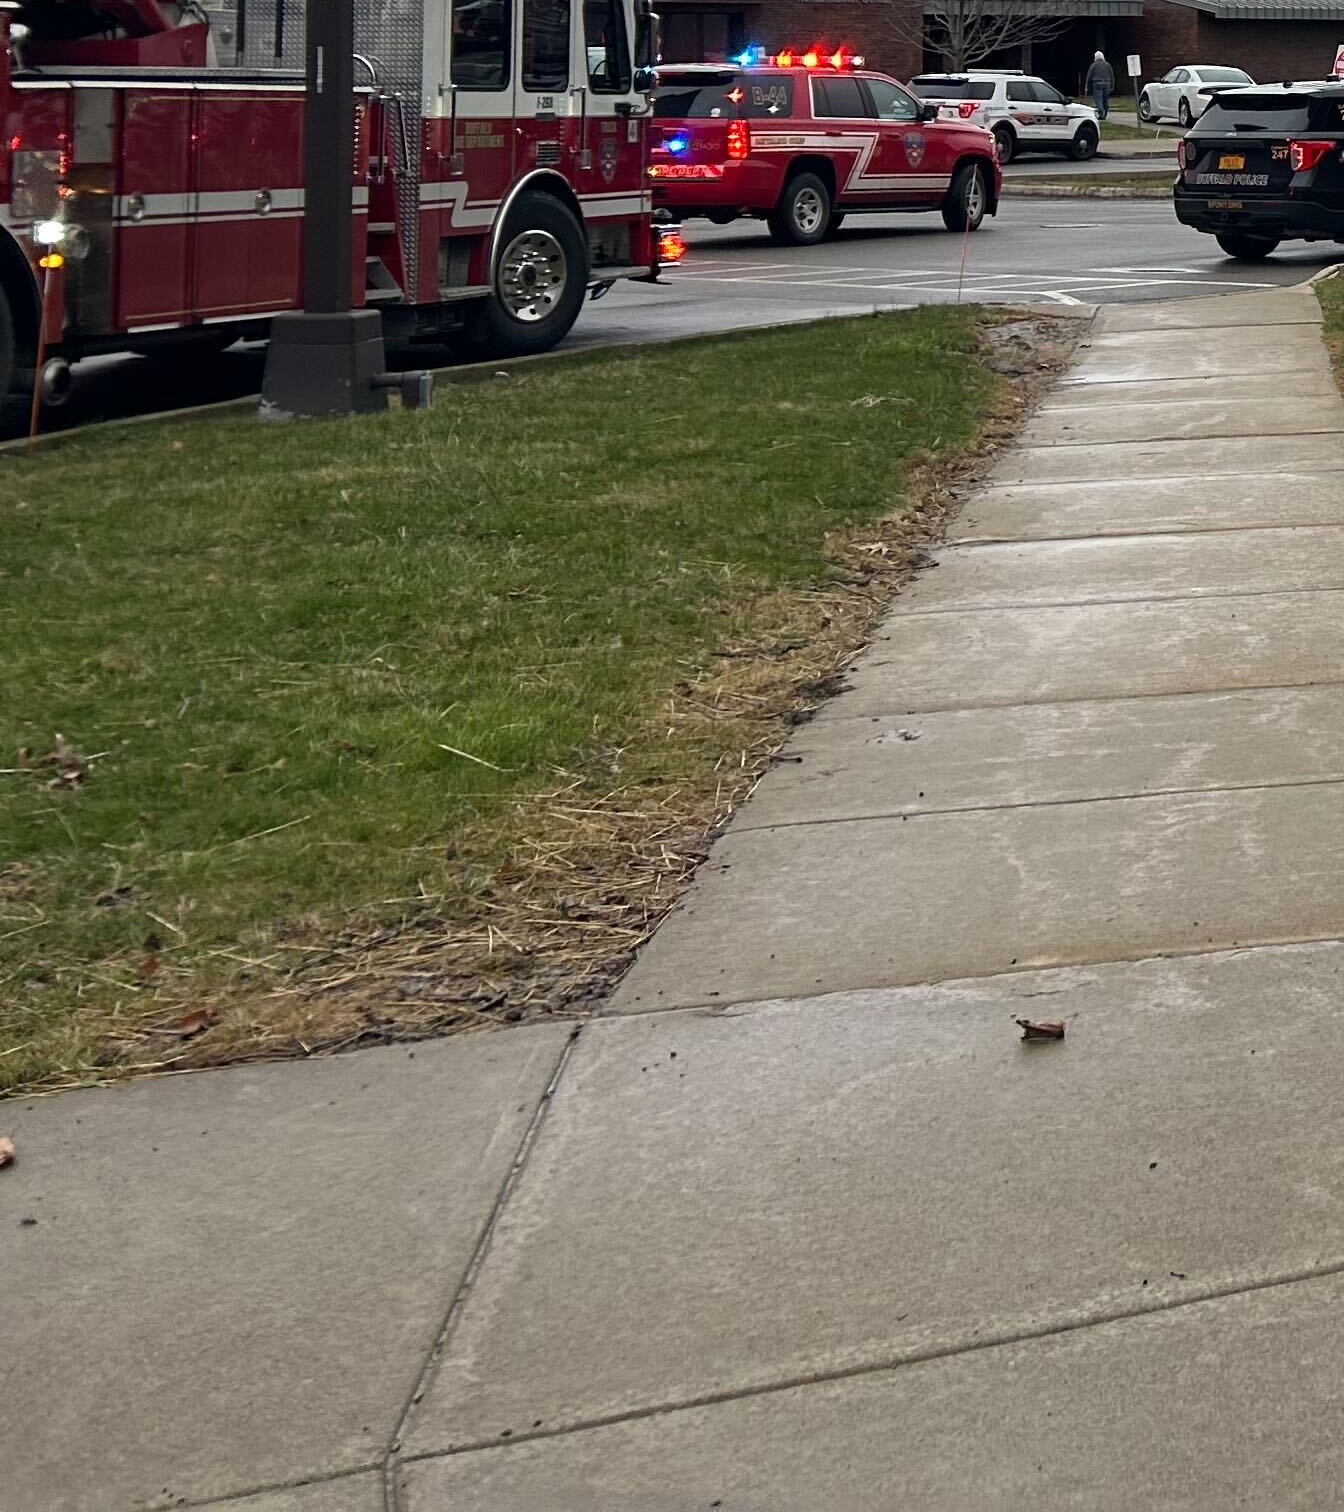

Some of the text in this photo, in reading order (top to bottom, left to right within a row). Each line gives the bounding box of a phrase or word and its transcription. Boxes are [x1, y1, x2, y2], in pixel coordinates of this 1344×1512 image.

[752, 85, 788, 106] B-44
[1271, 149, 1289, 160] 247
[1233, 174, 1269, 186] POLICE
